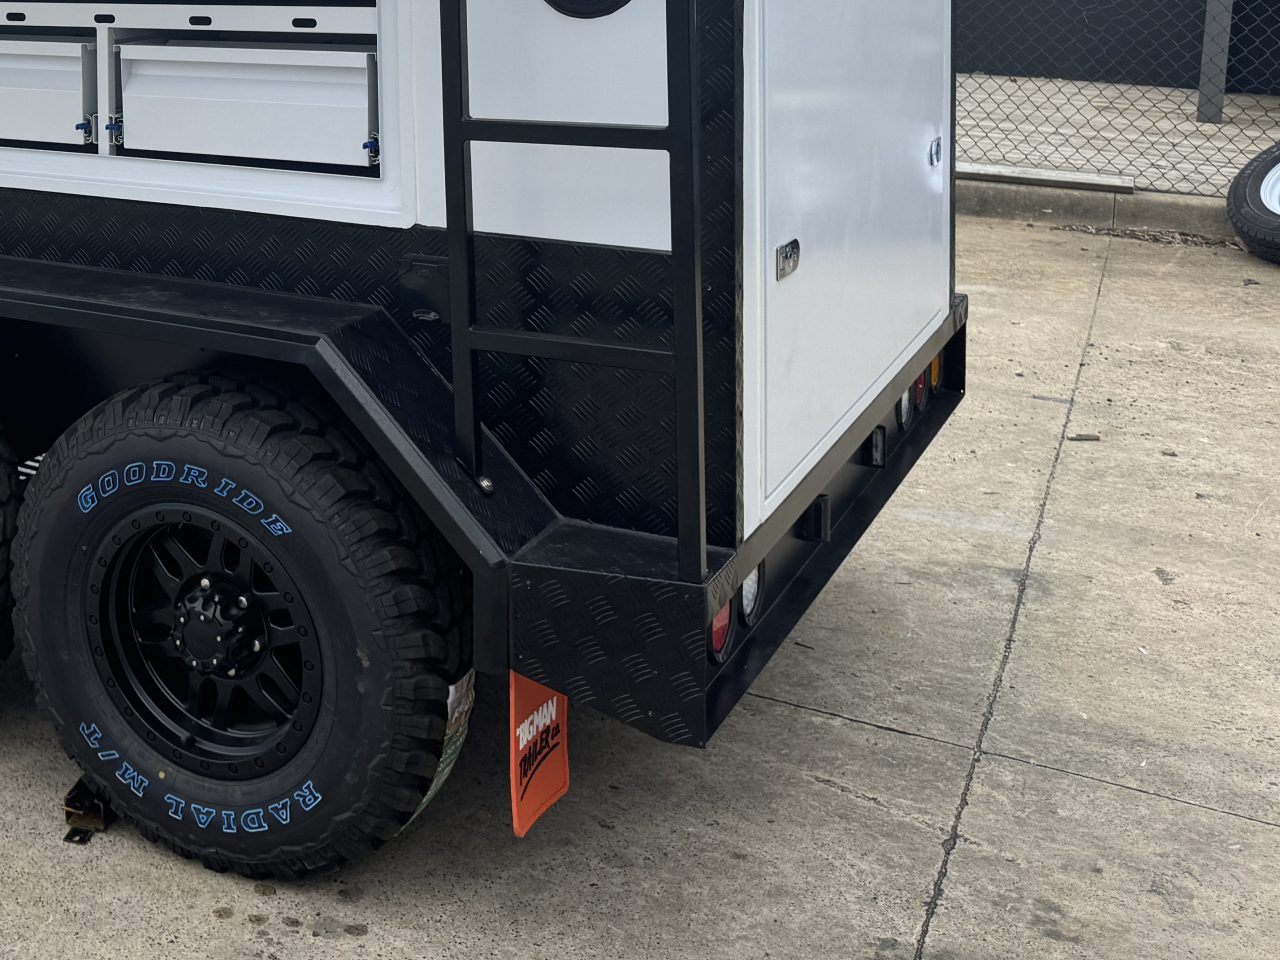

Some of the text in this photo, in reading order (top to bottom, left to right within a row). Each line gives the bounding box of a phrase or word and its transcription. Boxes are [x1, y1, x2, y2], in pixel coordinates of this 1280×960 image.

[77, 460, 293, 536] GOODRIDE
[79, 722, 322, 833] RADIAL M/T
[519, 725, 551, 786] TRAILER
